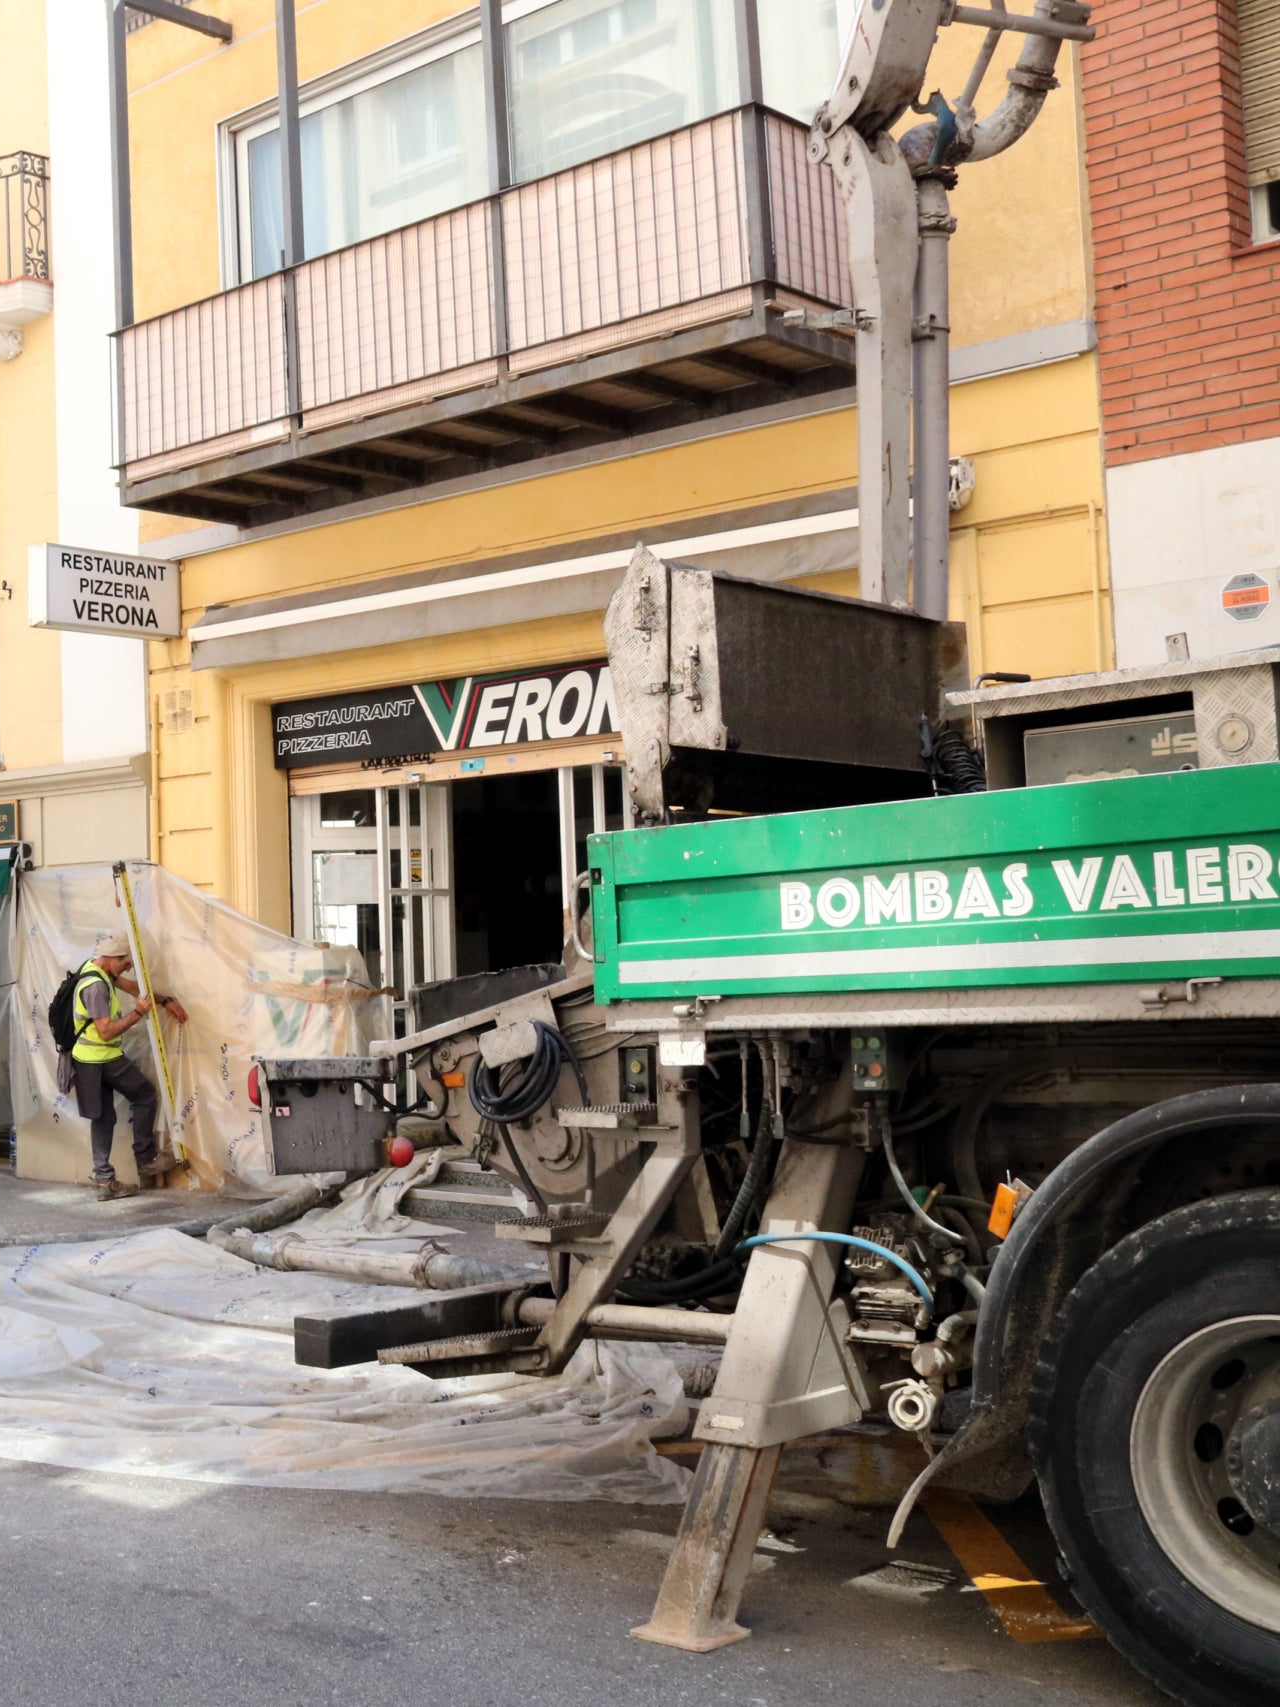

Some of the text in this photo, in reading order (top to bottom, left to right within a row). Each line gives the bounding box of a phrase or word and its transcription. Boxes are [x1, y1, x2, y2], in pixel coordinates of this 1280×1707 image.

[61, 552, 167, 582] RESTAURANT
[79, 577, 150, 602] PIZZERIA
[72, 598, 159, 629] VERONA
[276, 699, 416, 733] RESTAURANT
[278, 729, 372, 756] PIZZERIA
[779, 844, 1280, 931] BOMBAS VALER
